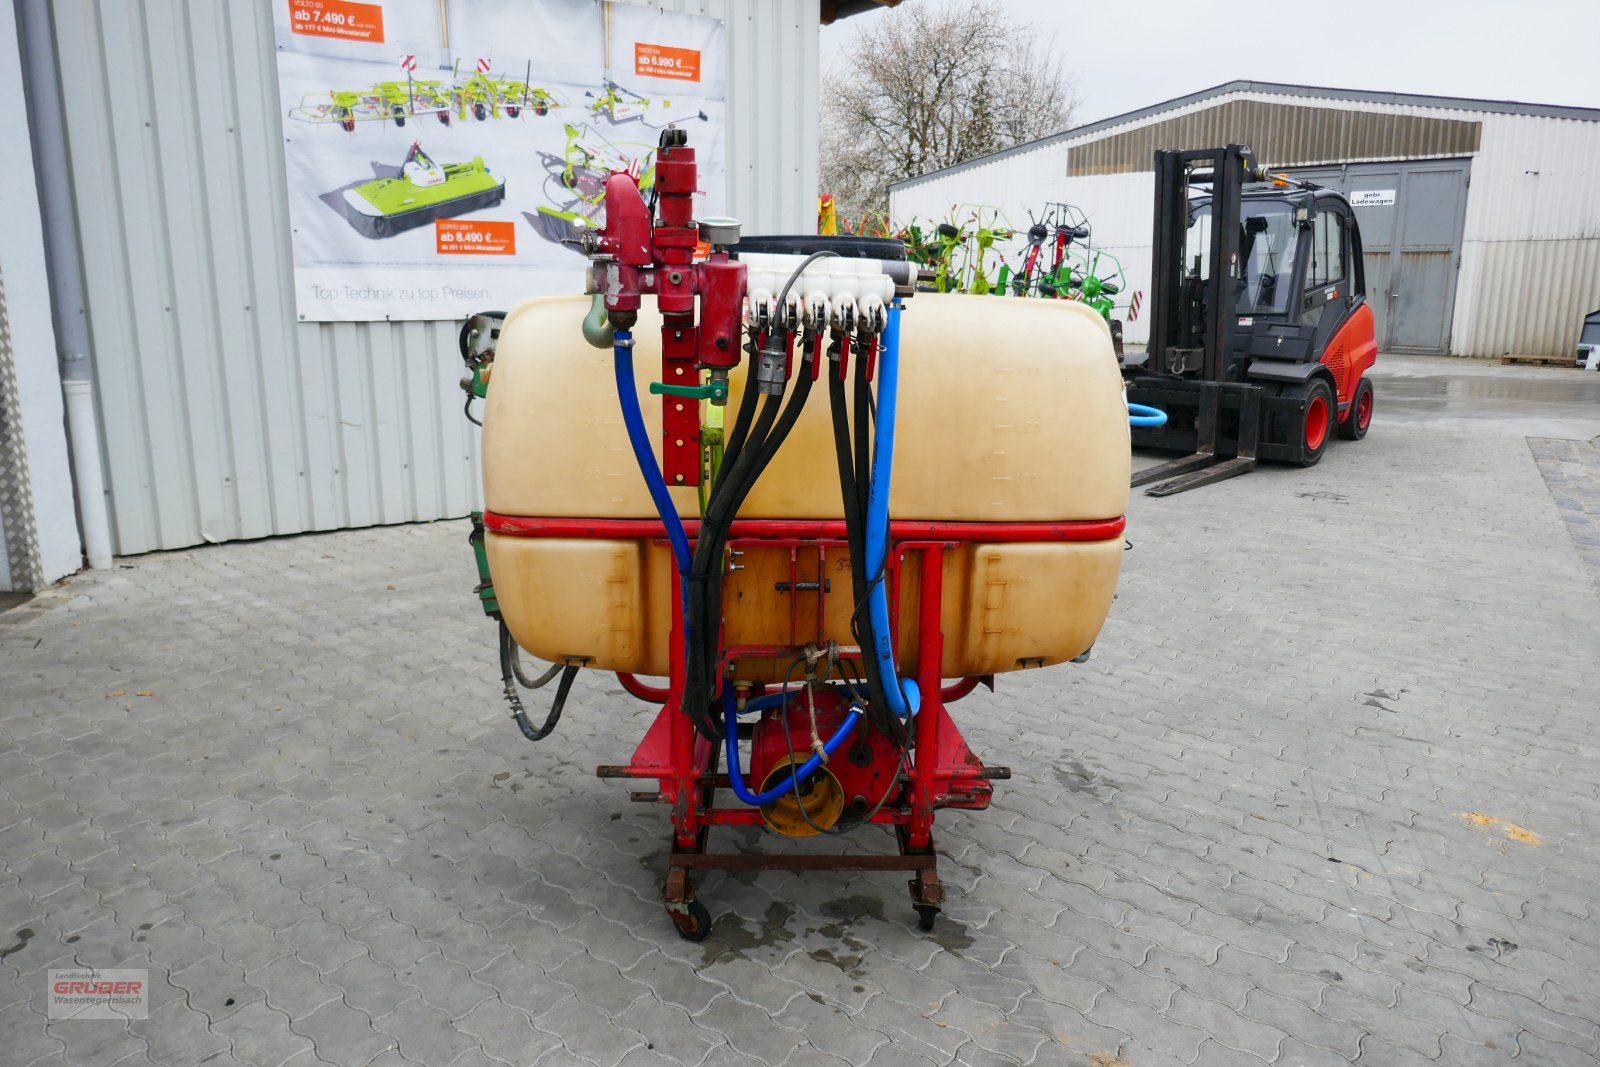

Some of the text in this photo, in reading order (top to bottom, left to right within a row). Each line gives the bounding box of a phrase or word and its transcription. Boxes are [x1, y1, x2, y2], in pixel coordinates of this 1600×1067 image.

[295, 9, 311, 21] ab
[313, 10, 345, 25] 7.490
[348, 15, 356, 26] €
[638, 55, 650, 65] ab
[651, 56, 674, 68] 6.990
[675, 58, 682, 69] €
[440, 232, 492, 243] ab 8.490 €
[312, 285, 492, 302] Top Technik zu top Preisen.
